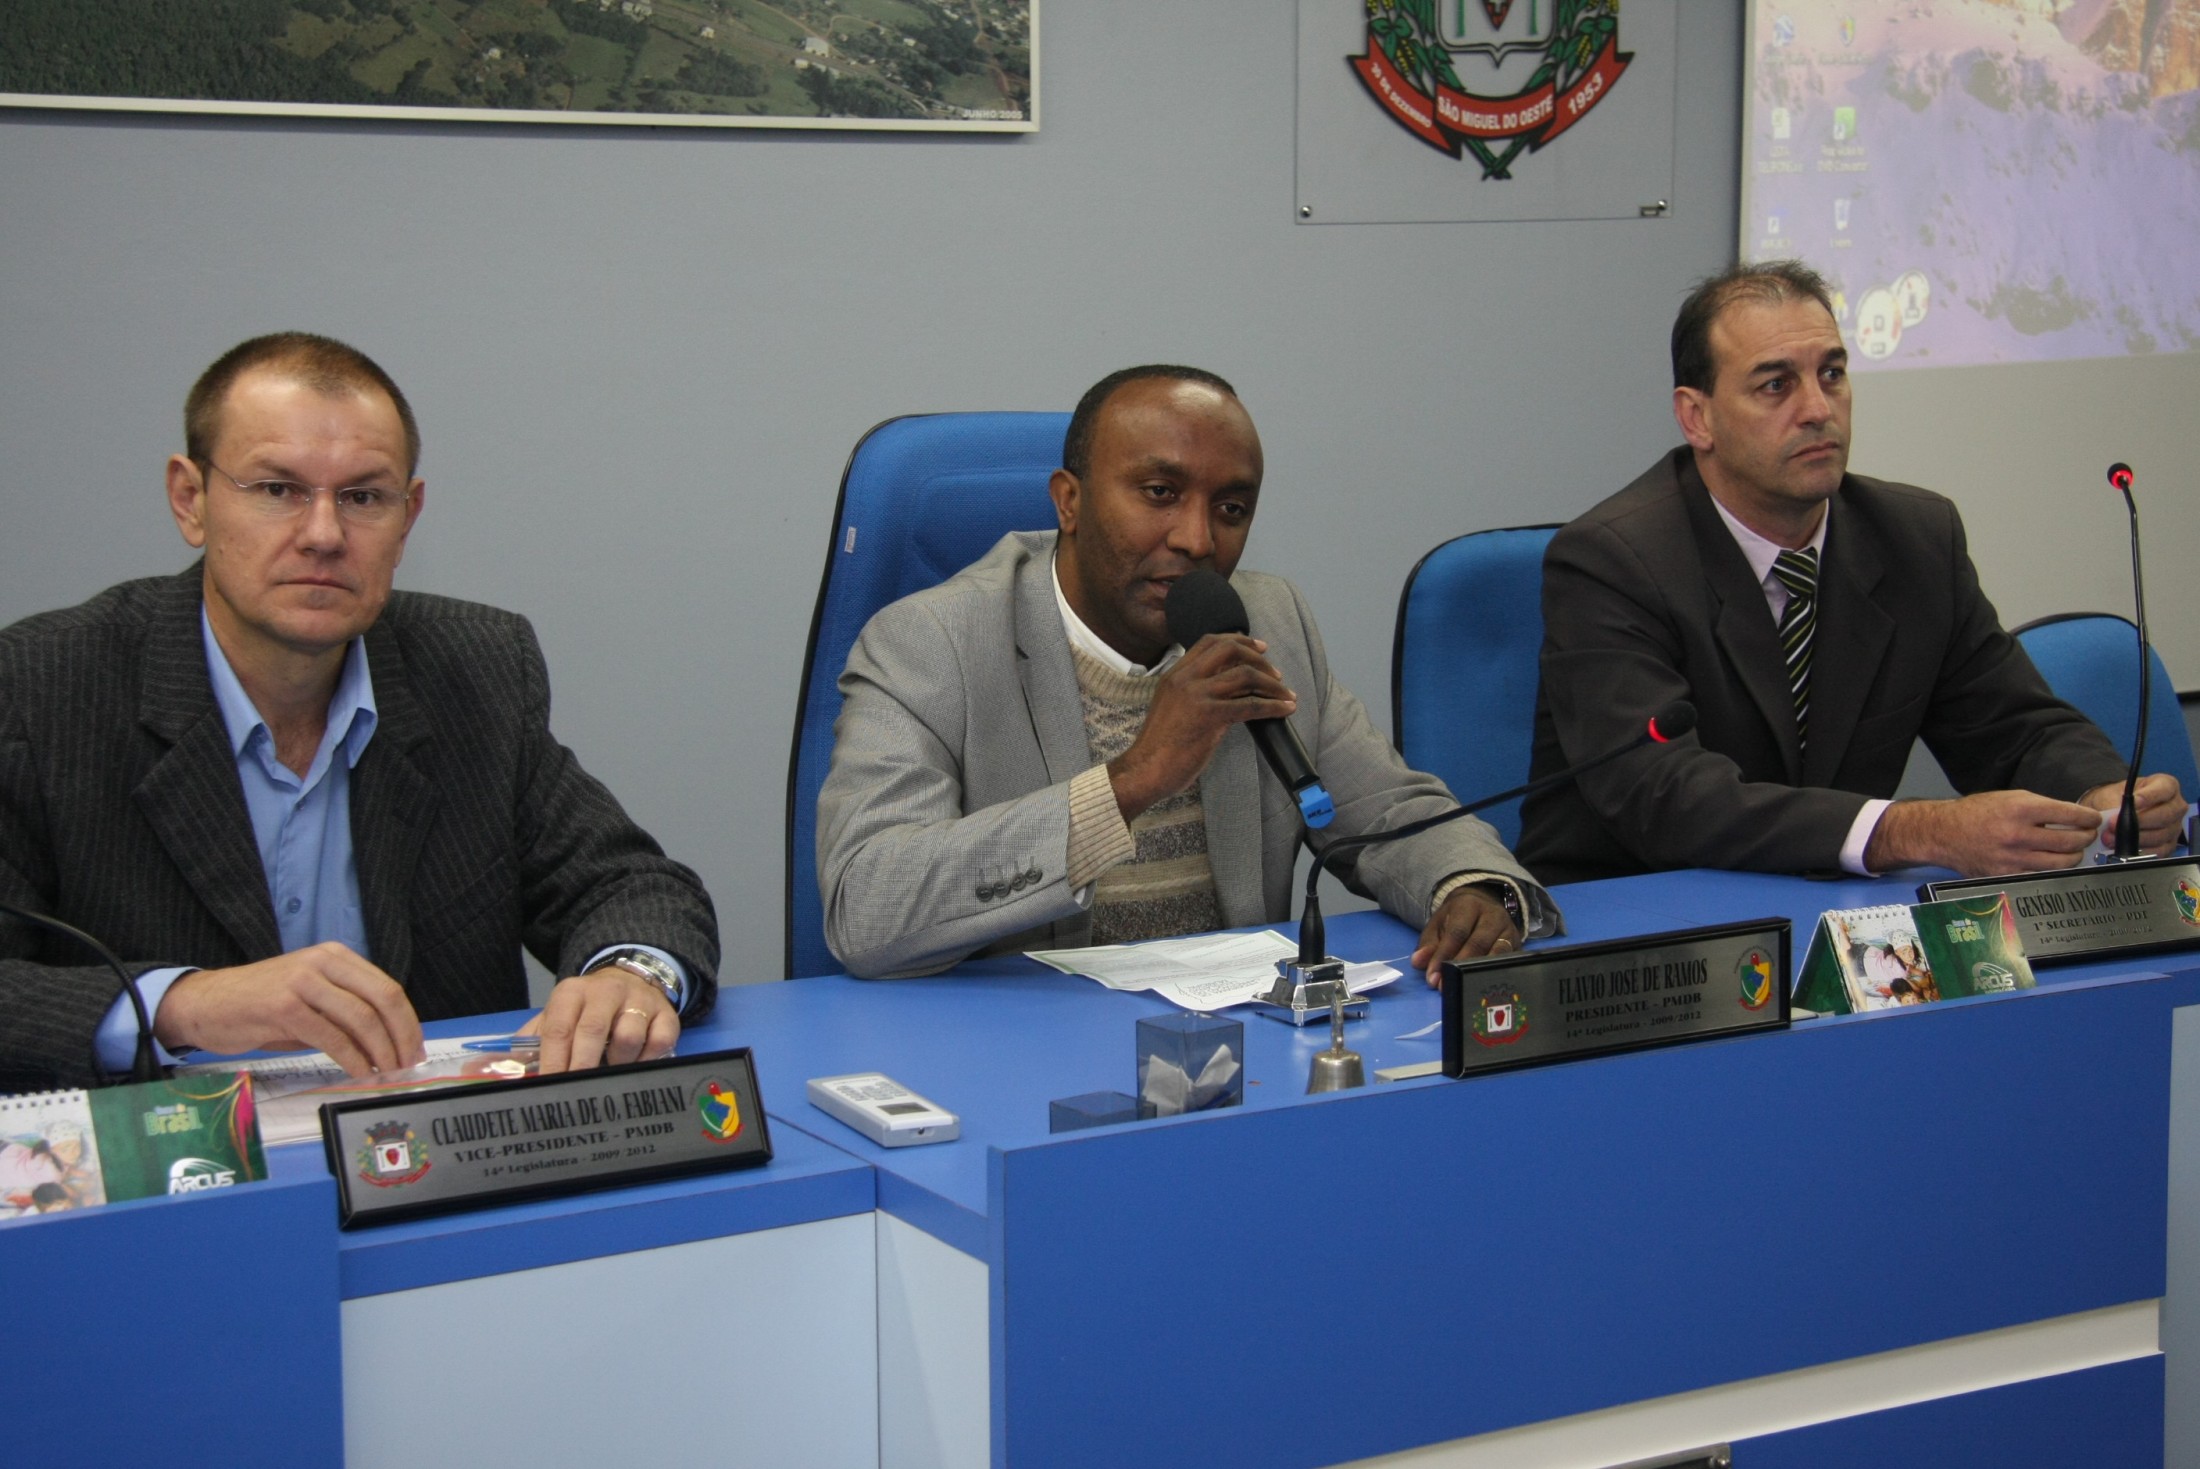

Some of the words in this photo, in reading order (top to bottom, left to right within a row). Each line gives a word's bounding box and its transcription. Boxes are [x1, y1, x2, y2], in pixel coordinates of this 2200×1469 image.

[1567, 72, 1603, 115] 1953
[962, 108, 997, 119] JUNHO
[1437, 95, 1459, 122] SÃO
[1461, 110, 1500, 130] MIGUEL
[1502, 112, 1517, 129] DO
[1519, 94, 1554, 126] OESTE
[2015, 889, 2065, 919] GENÉSIO
[2064, 884, 2116, 914] ANTÔNIO
[2115, 883, 2153, 908] COLLE
[2046, 912, 2116, 931] SECRETÁRIO
[2126, 911, 2149, 921] PDT
[1558, 968, 1605, 1005] FLÁVIO
[1608, 961, 1639, 998] JOSÉ
[1643, 965, 1661, 993] DE
[1664, 958, 1708, 990] RAMOS
[1973, 973, 2014, 991] ARCUS
[1565, 1001, 1650, 1023] PRESIDENTE
[1663, 992, 1702, 1008] PMDB
[1585, 1020, 1641, 1037] Legislatura
[143, 1105, 204, 1136] Brasil
[431, 1108, 519, 1147] CLAUDETE
[519, 1099, 577, 1135] MARIA
[577, 1096, 603, 1127] DE
[603, 1091, 621, 1123] O.
[621, 1085, 687, 1120] FABIANI
[453, 1130, 609, 1163] VICE-PRESIDENTE
[624, 1121, 674, 1140] PMDB
[507, 1157, 579, 1176] Legislatura
[168, 1170, 237, 1196] ARCUS
